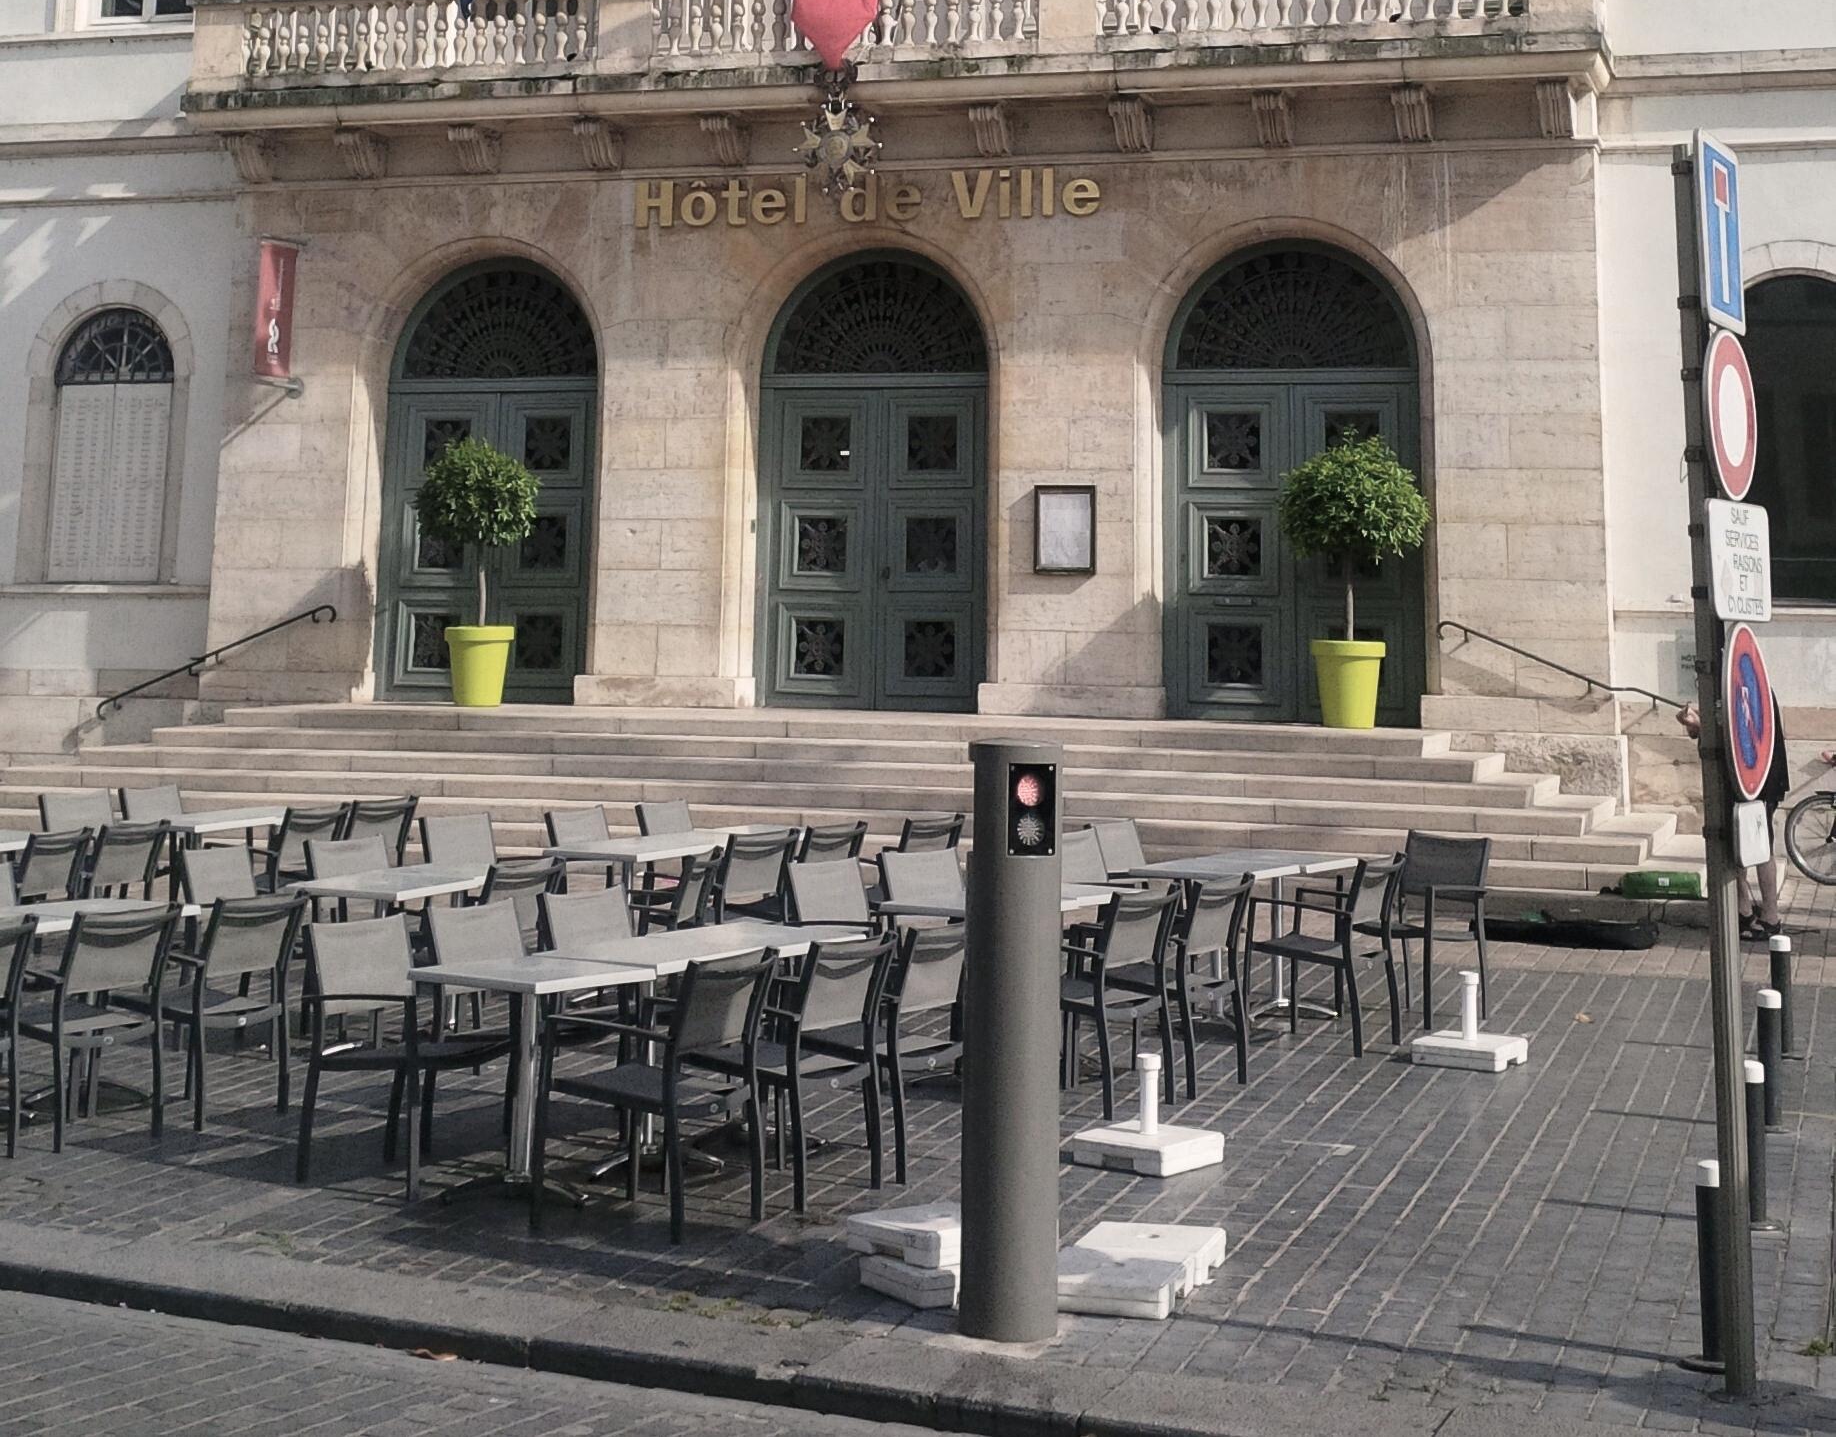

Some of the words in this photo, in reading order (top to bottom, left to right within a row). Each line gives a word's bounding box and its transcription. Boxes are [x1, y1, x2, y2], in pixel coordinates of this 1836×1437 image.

[634, 175, 807, 228] Hôtel
[840, 174, 923, 223] de
[951, 167, 1101, 219] Ville
[1731, 506, 1749, 525] SAUF
[1725, 529, 1759, 551] SERVICES
[1739, 574, 1748, 592] ET
[1727, 594, 1763, 616] CYCLISTES
